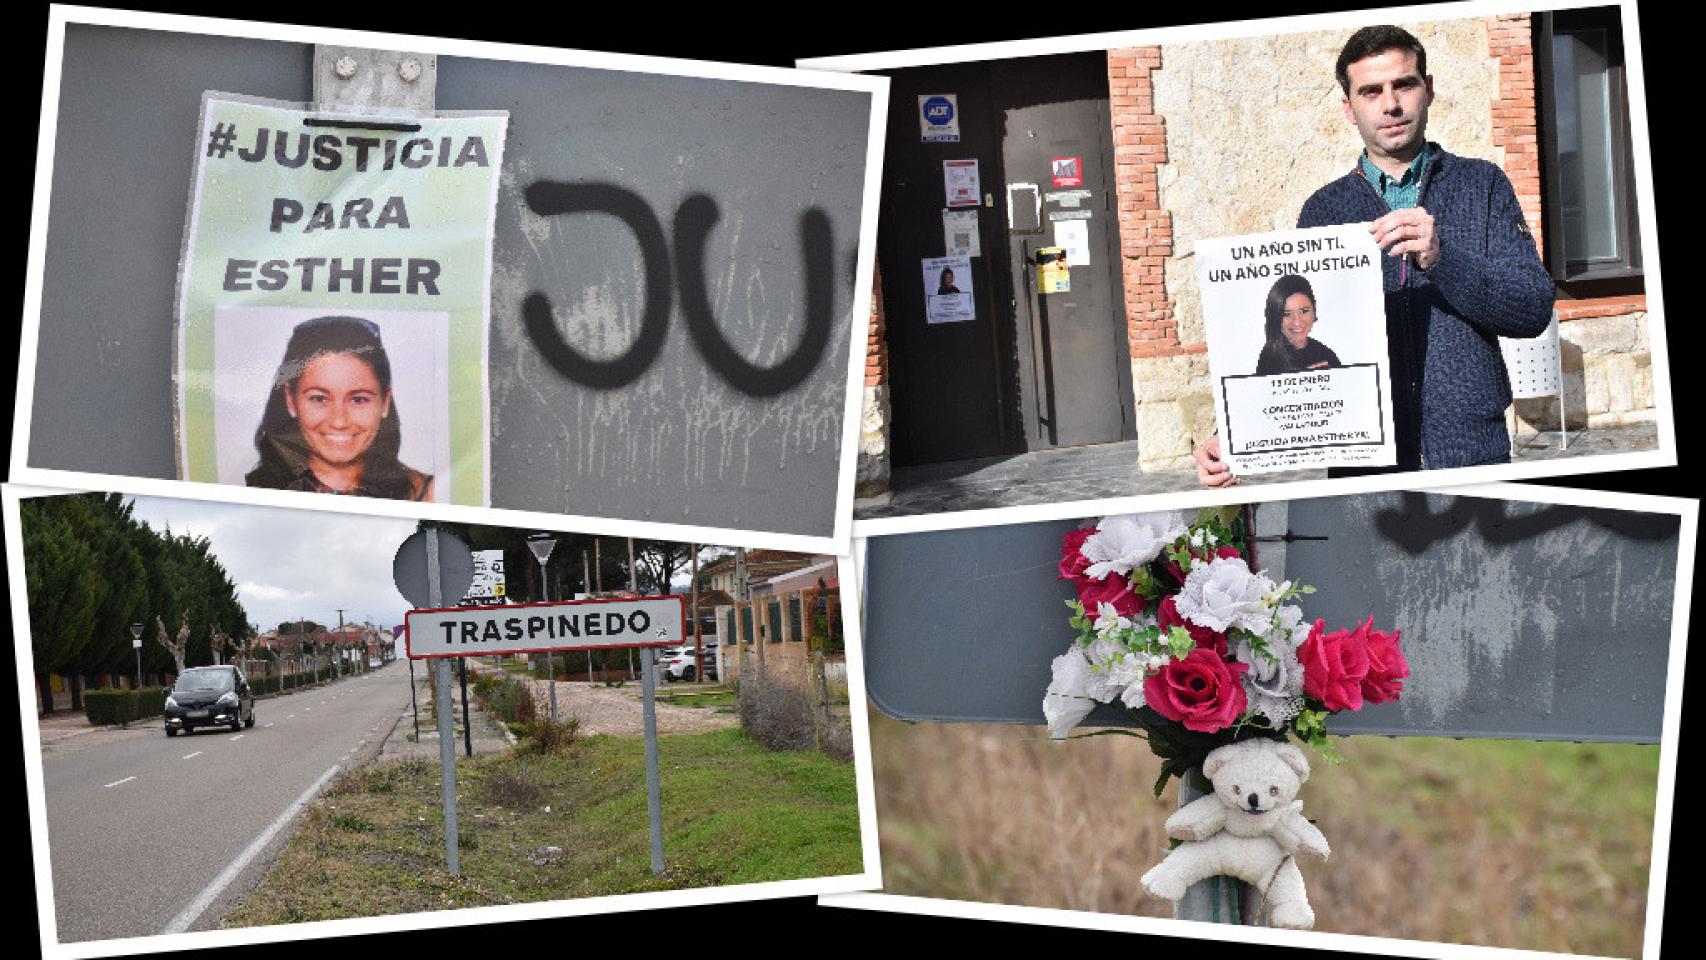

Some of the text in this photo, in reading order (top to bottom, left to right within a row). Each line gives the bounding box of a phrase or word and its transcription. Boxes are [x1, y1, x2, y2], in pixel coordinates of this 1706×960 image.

[929, 106, 949, 117] ADT
[206, 121, 489, 172] #JUSTICIA
[269, 196, 411, 233] PARA
[1231, 246, 1255, 260] UN
[1259, 241, 1294, 257] AÑO
[1297, 238, 1322, 253] SIN
[222, 257, 441, 296] ESTHER
[1209, 254, 1371, 282] UN AÑO SIN JUSTICIA
[440, 609, 651, 644] TRASPINEDO
